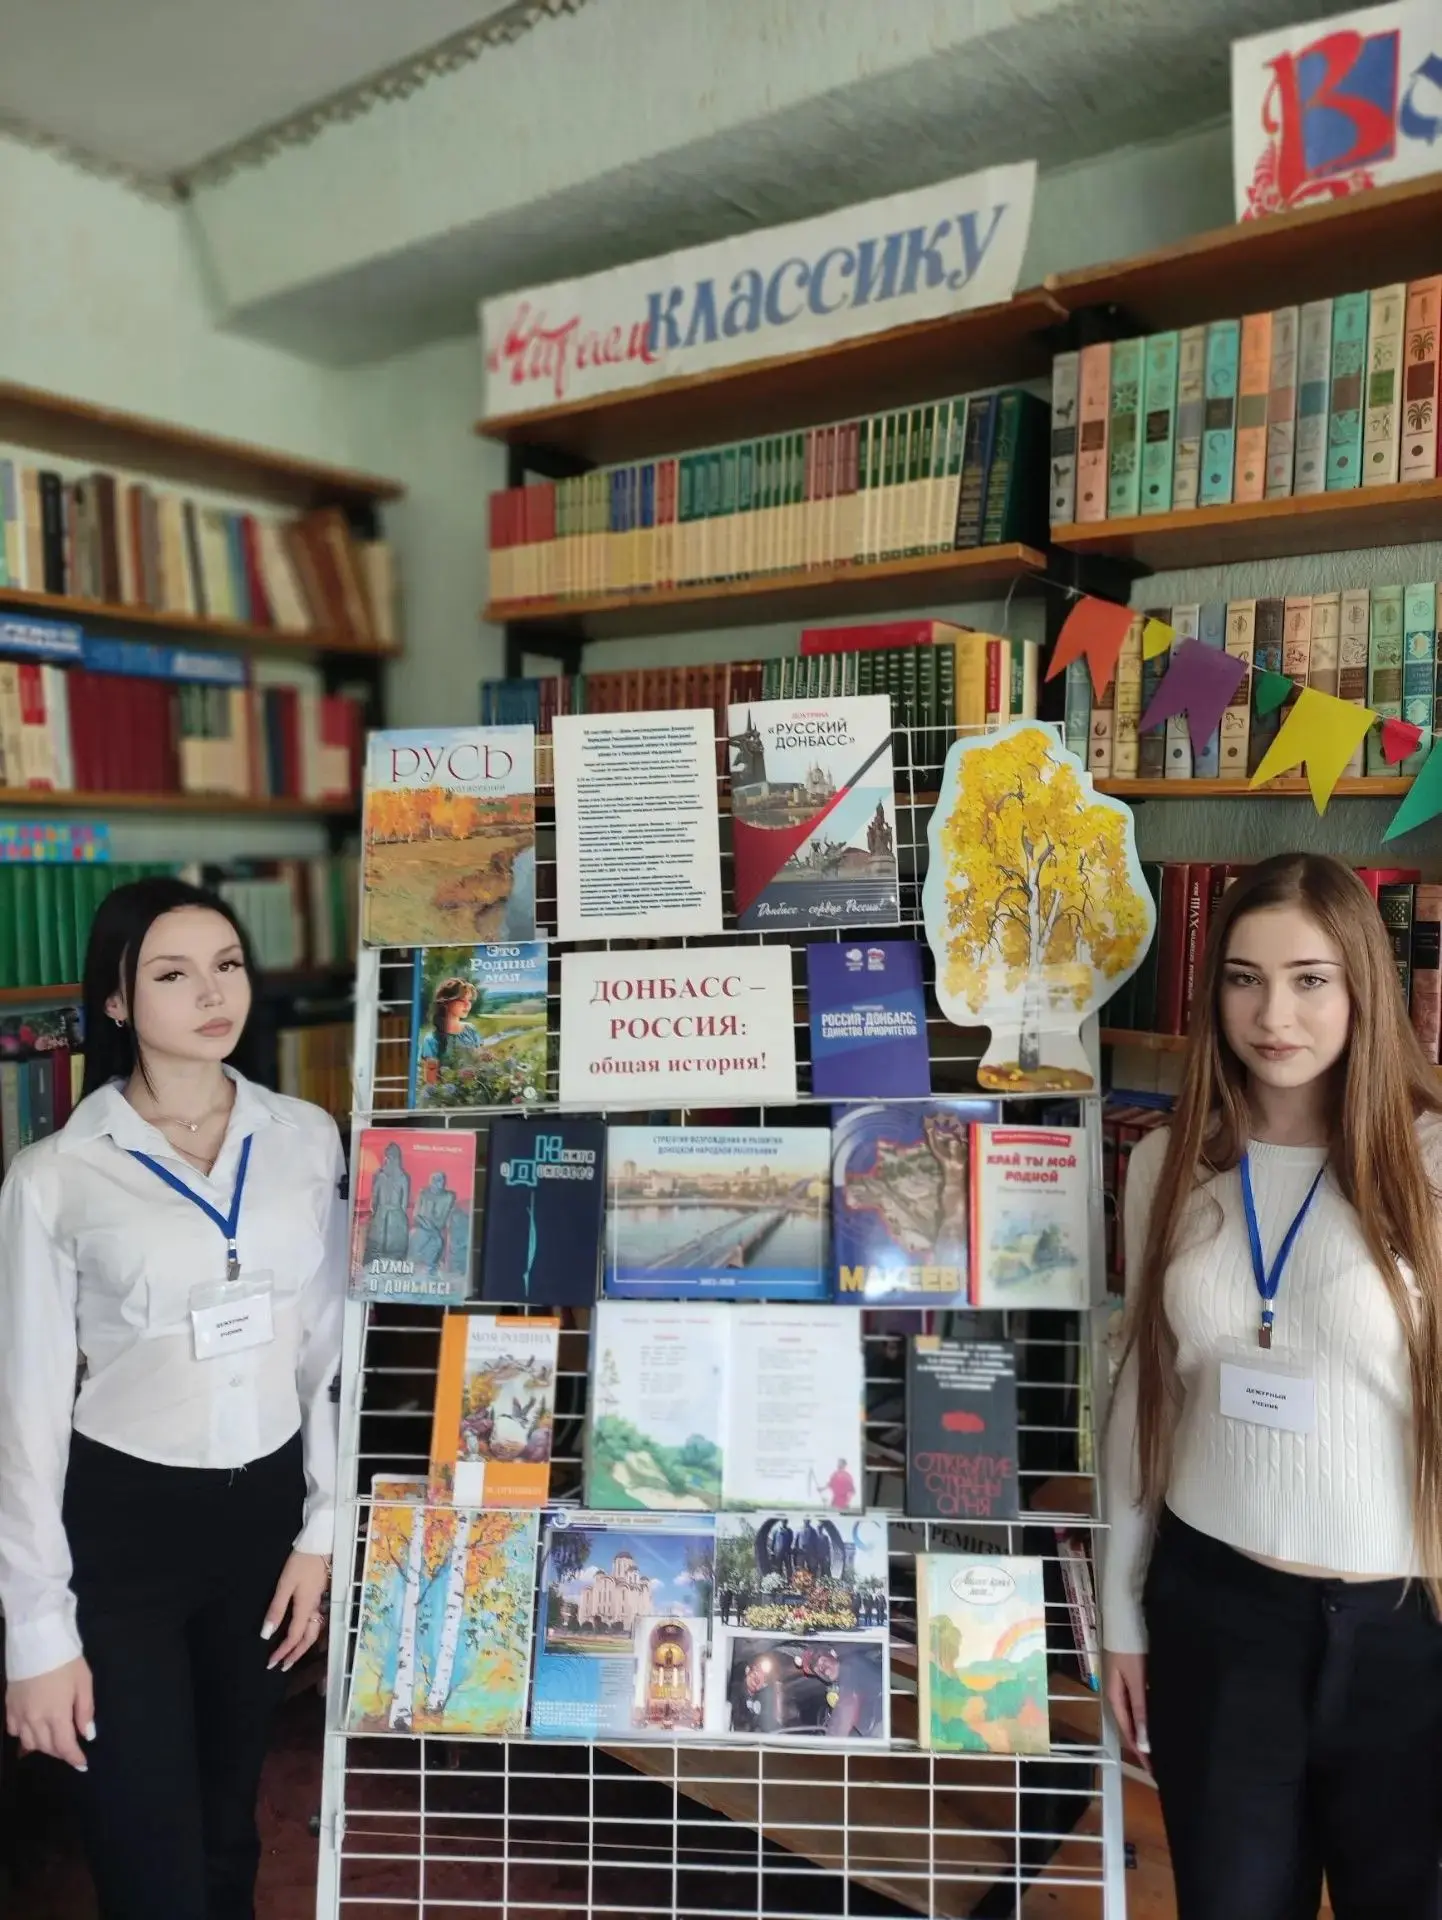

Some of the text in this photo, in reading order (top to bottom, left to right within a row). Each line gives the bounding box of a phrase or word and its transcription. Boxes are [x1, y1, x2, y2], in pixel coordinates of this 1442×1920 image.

[767, 717, 847, 735] «РУССКИЙ
[775, 734, 855, 750] ДОНБАСС»
[486, 945, 521, 957] Это
[470, 958, 537, 972] Родина
[590, 975, 742, 1005] ДОНБАСС
[609, 1014, 747, 1040] РОССИЯ:
[589, 1051, 767, 1076] общая история!
[987, 1152, 1077, 1168] КРАЙ ТЫ МОЙ
[1004, 1169, 1059, 1183] РОДНОЙ
[370, 1259, 414, 1275] ДУМЫ
[370, 1279, 378, 1292] О
